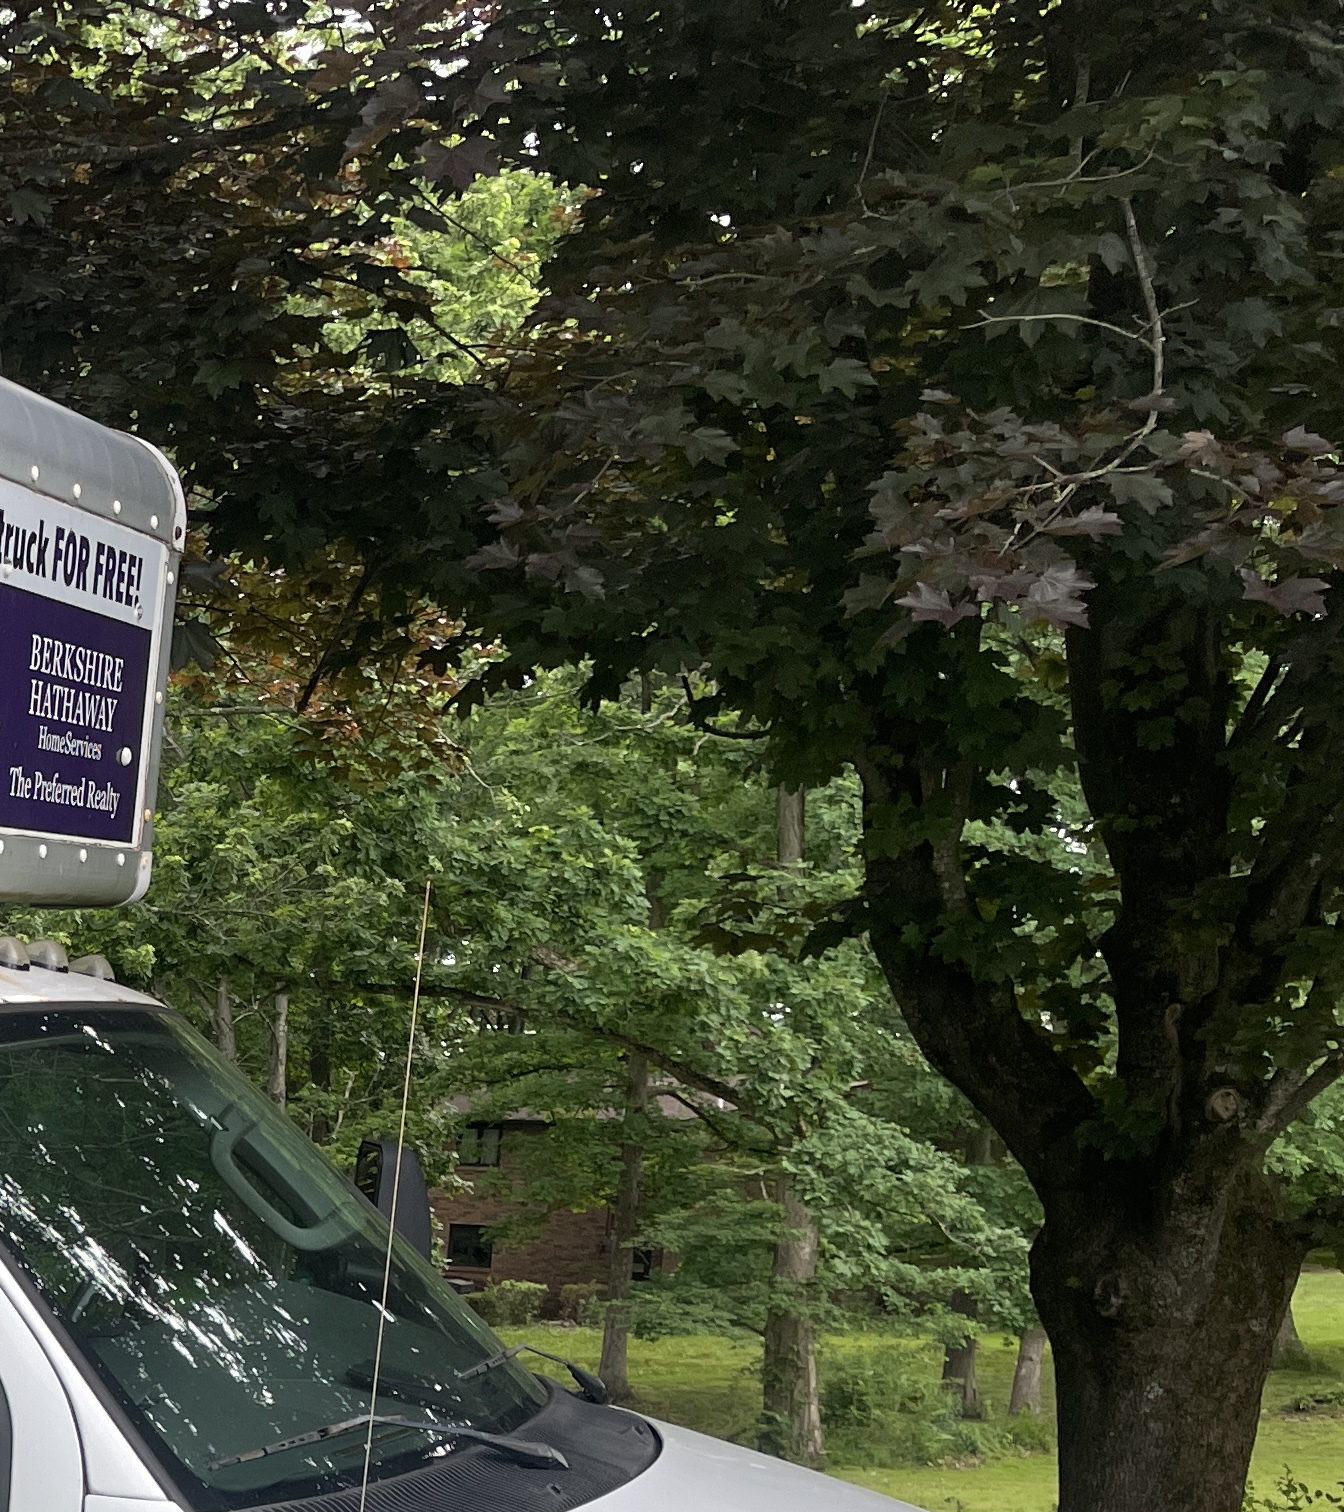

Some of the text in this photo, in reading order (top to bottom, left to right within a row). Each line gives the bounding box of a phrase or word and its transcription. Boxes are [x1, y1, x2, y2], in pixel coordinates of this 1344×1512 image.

[52, 526, 89, 594] FOR
[92, 542, 144, 612] FREE!
[29, 634, 124, 692] BERKSHIRE
[28, 680, 118, 732] HATHAWAY
[38, 725, 103, 762] HomeServices
[9, 767, 120, 819] The Preferred Realty
